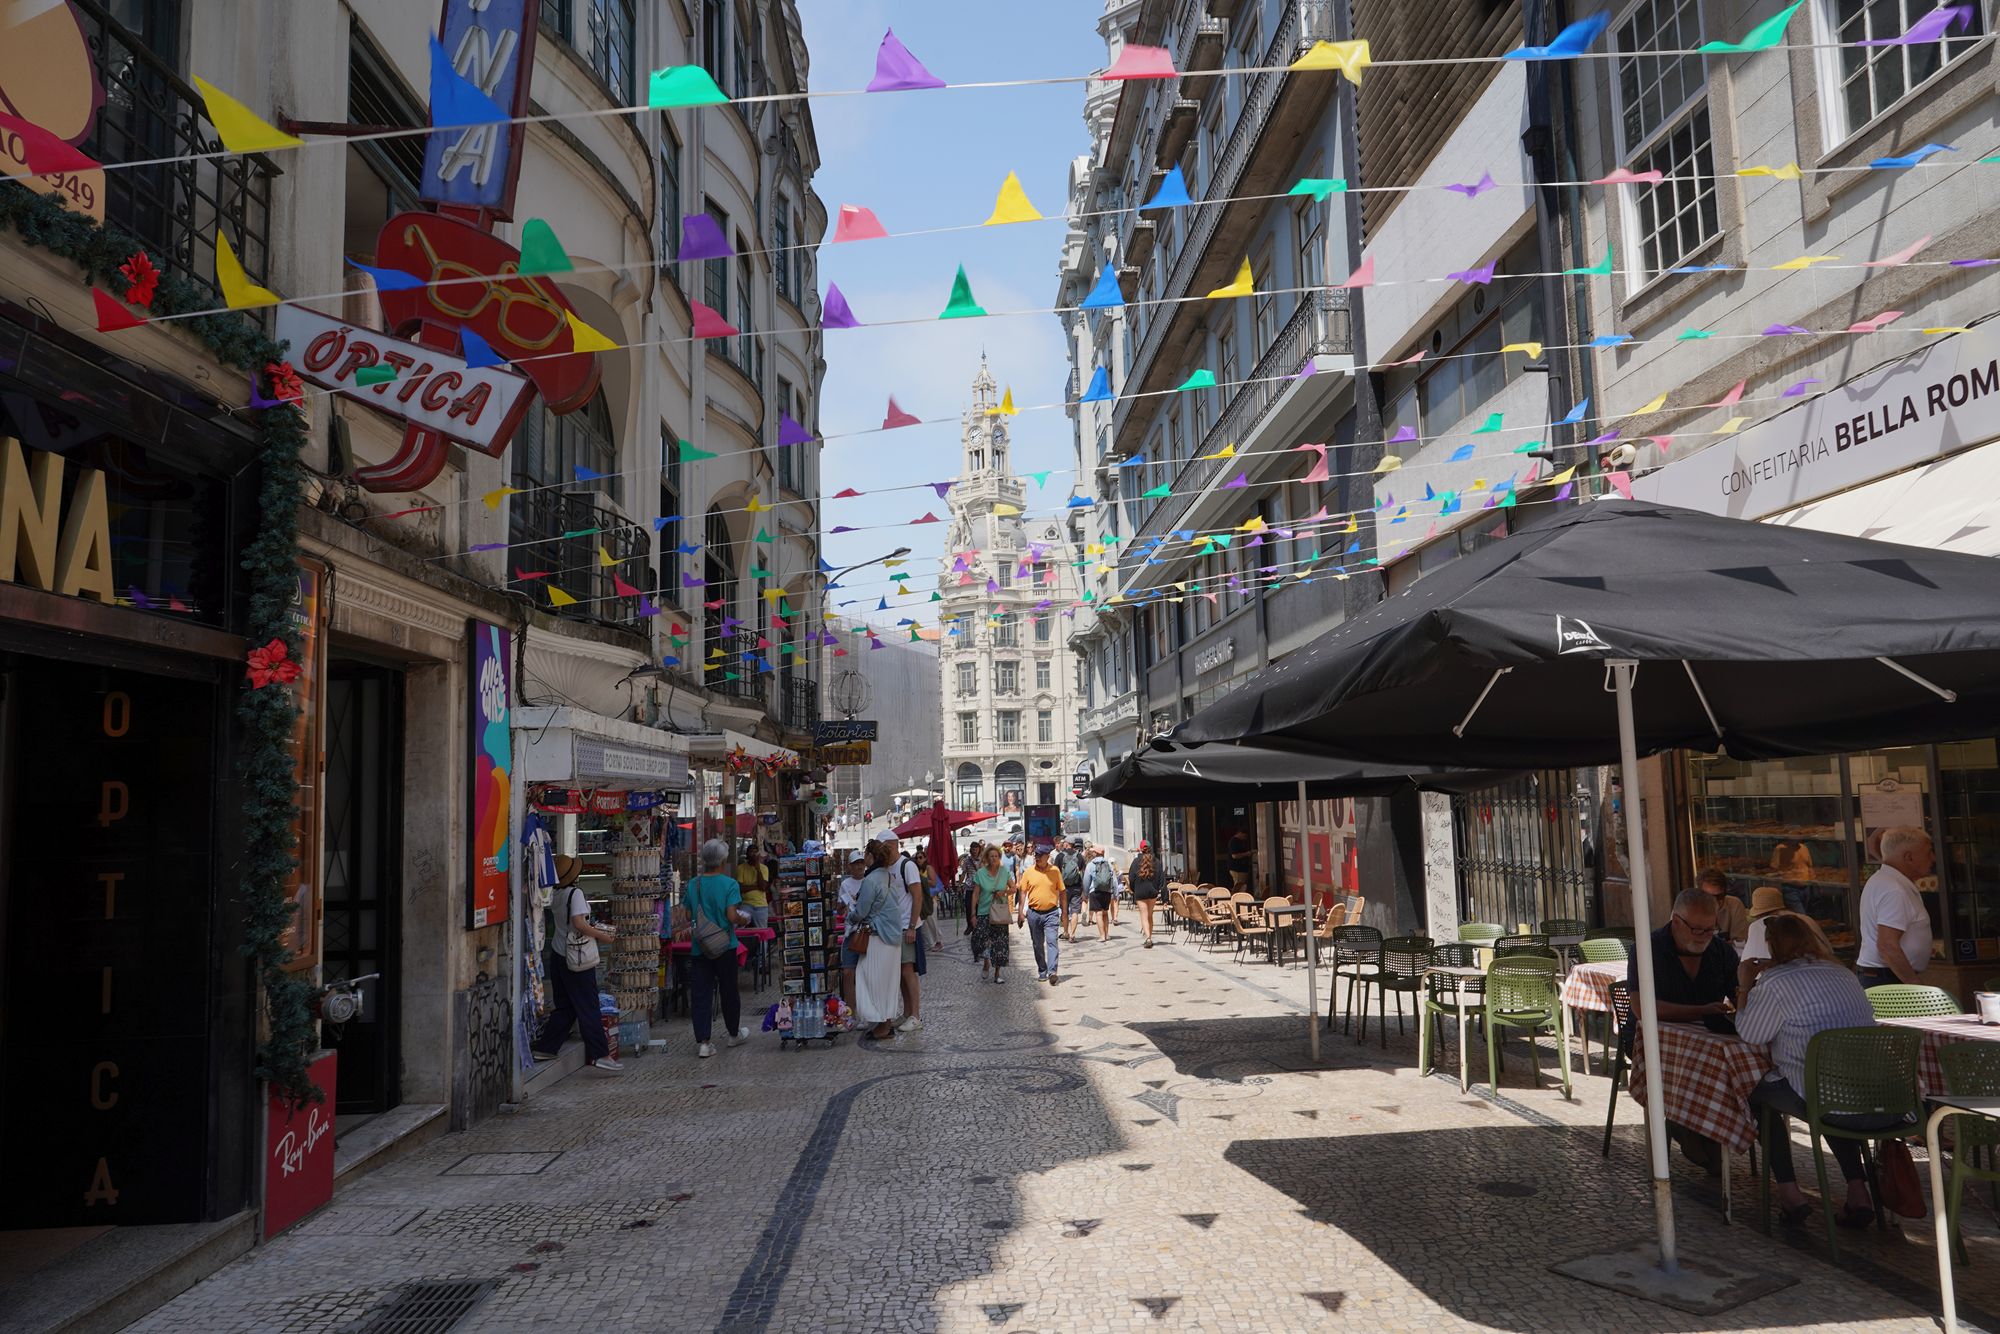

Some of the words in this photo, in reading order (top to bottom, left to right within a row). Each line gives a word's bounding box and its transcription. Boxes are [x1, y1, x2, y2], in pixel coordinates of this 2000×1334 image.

[436, 0, 519, 187] NA
[303, 326, 493, 426] ÓPTICA
[1720, 436, 1830, 497] CONFEITARIA
[1834, 388, 1920, 453] BELLA
[1926, 358, 2000, 418] ROM
[814, 721, 877, 742] Lotarias
[1074, 775, 1087, 783] ATM
[482, 855, 500, 866] PORTO
[83, 689, 131, 1207] OPTICA
